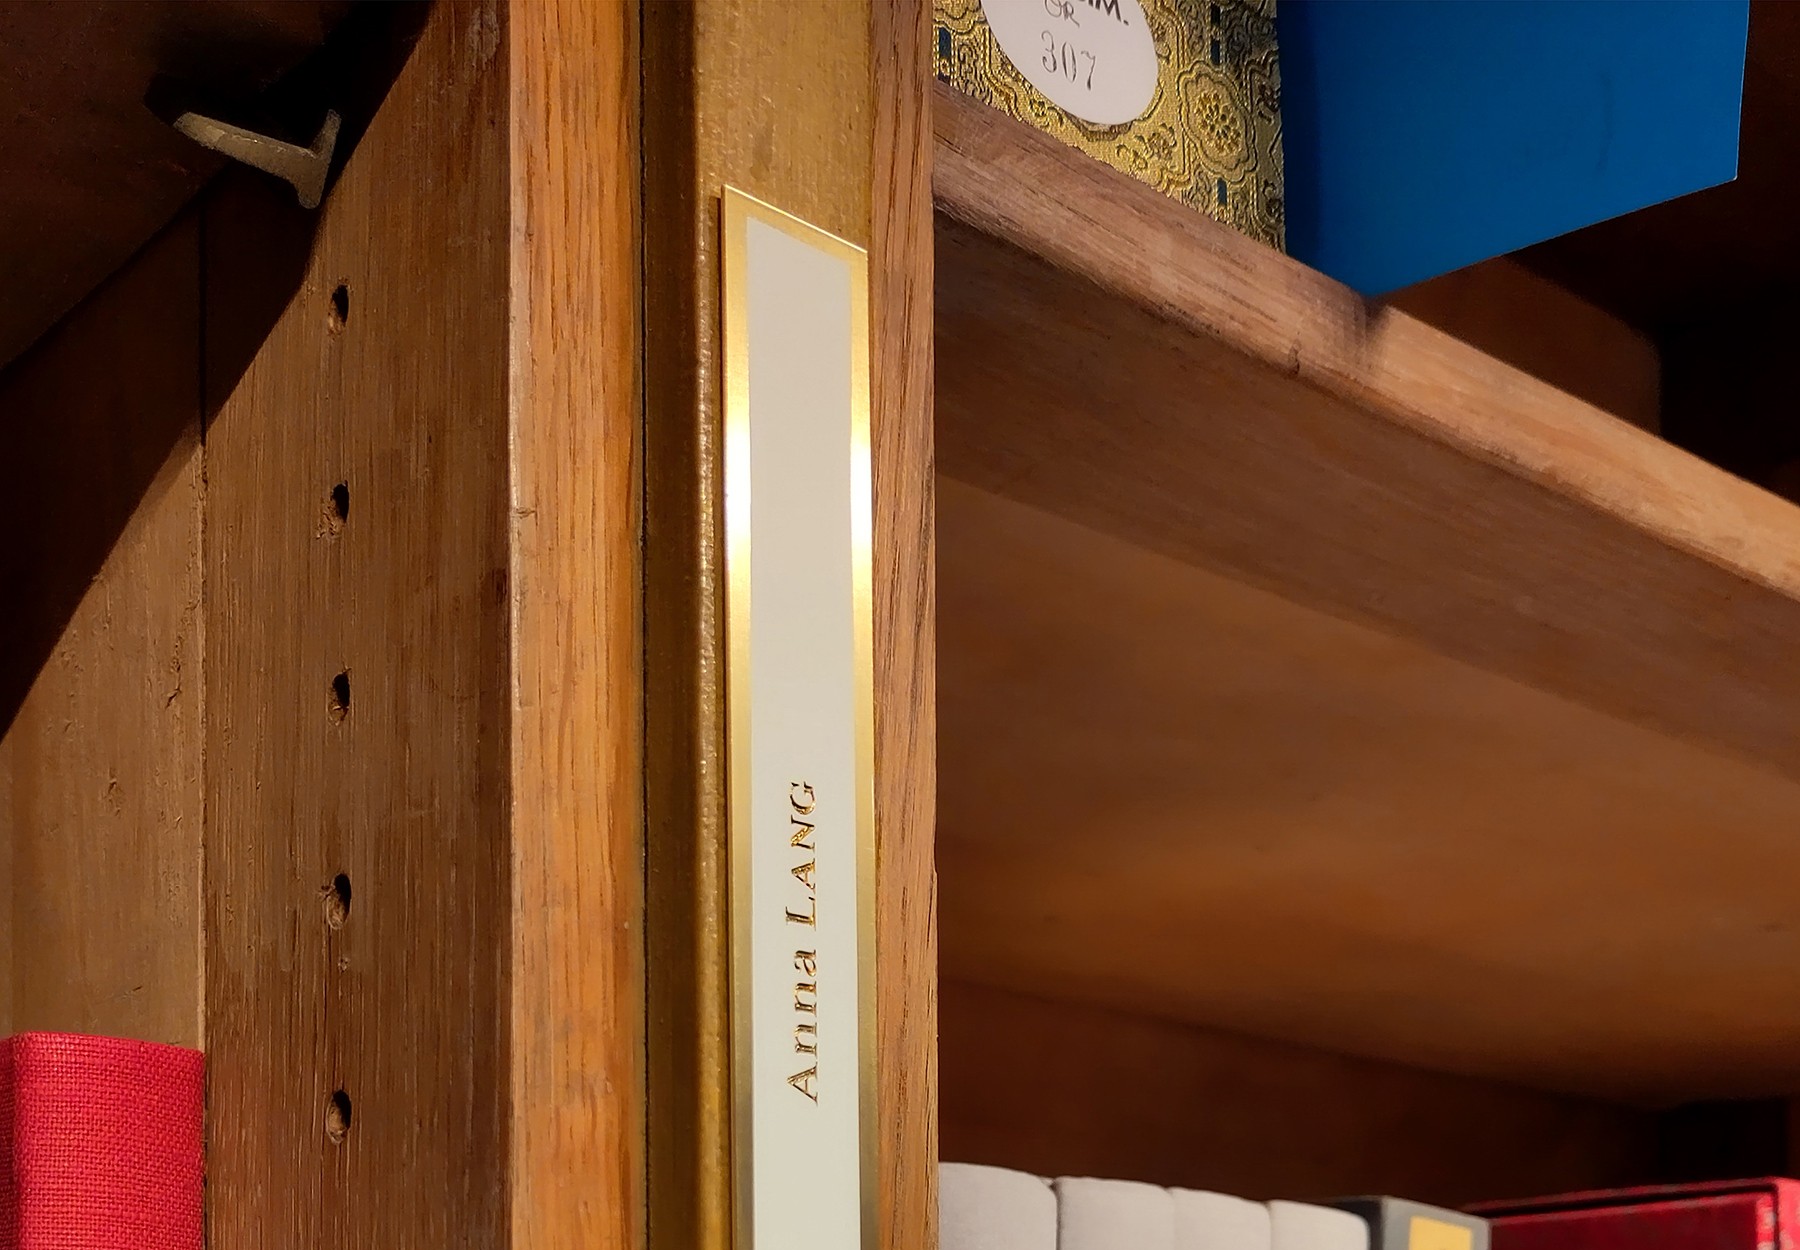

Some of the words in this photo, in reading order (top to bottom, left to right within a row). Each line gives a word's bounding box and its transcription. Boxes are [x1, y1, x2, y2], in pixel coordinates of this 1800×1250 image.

[1041, 29, 1096, 91] 307
[786, 781, 817, 931] LANG
[787, 949, 818, 1106] Anna
